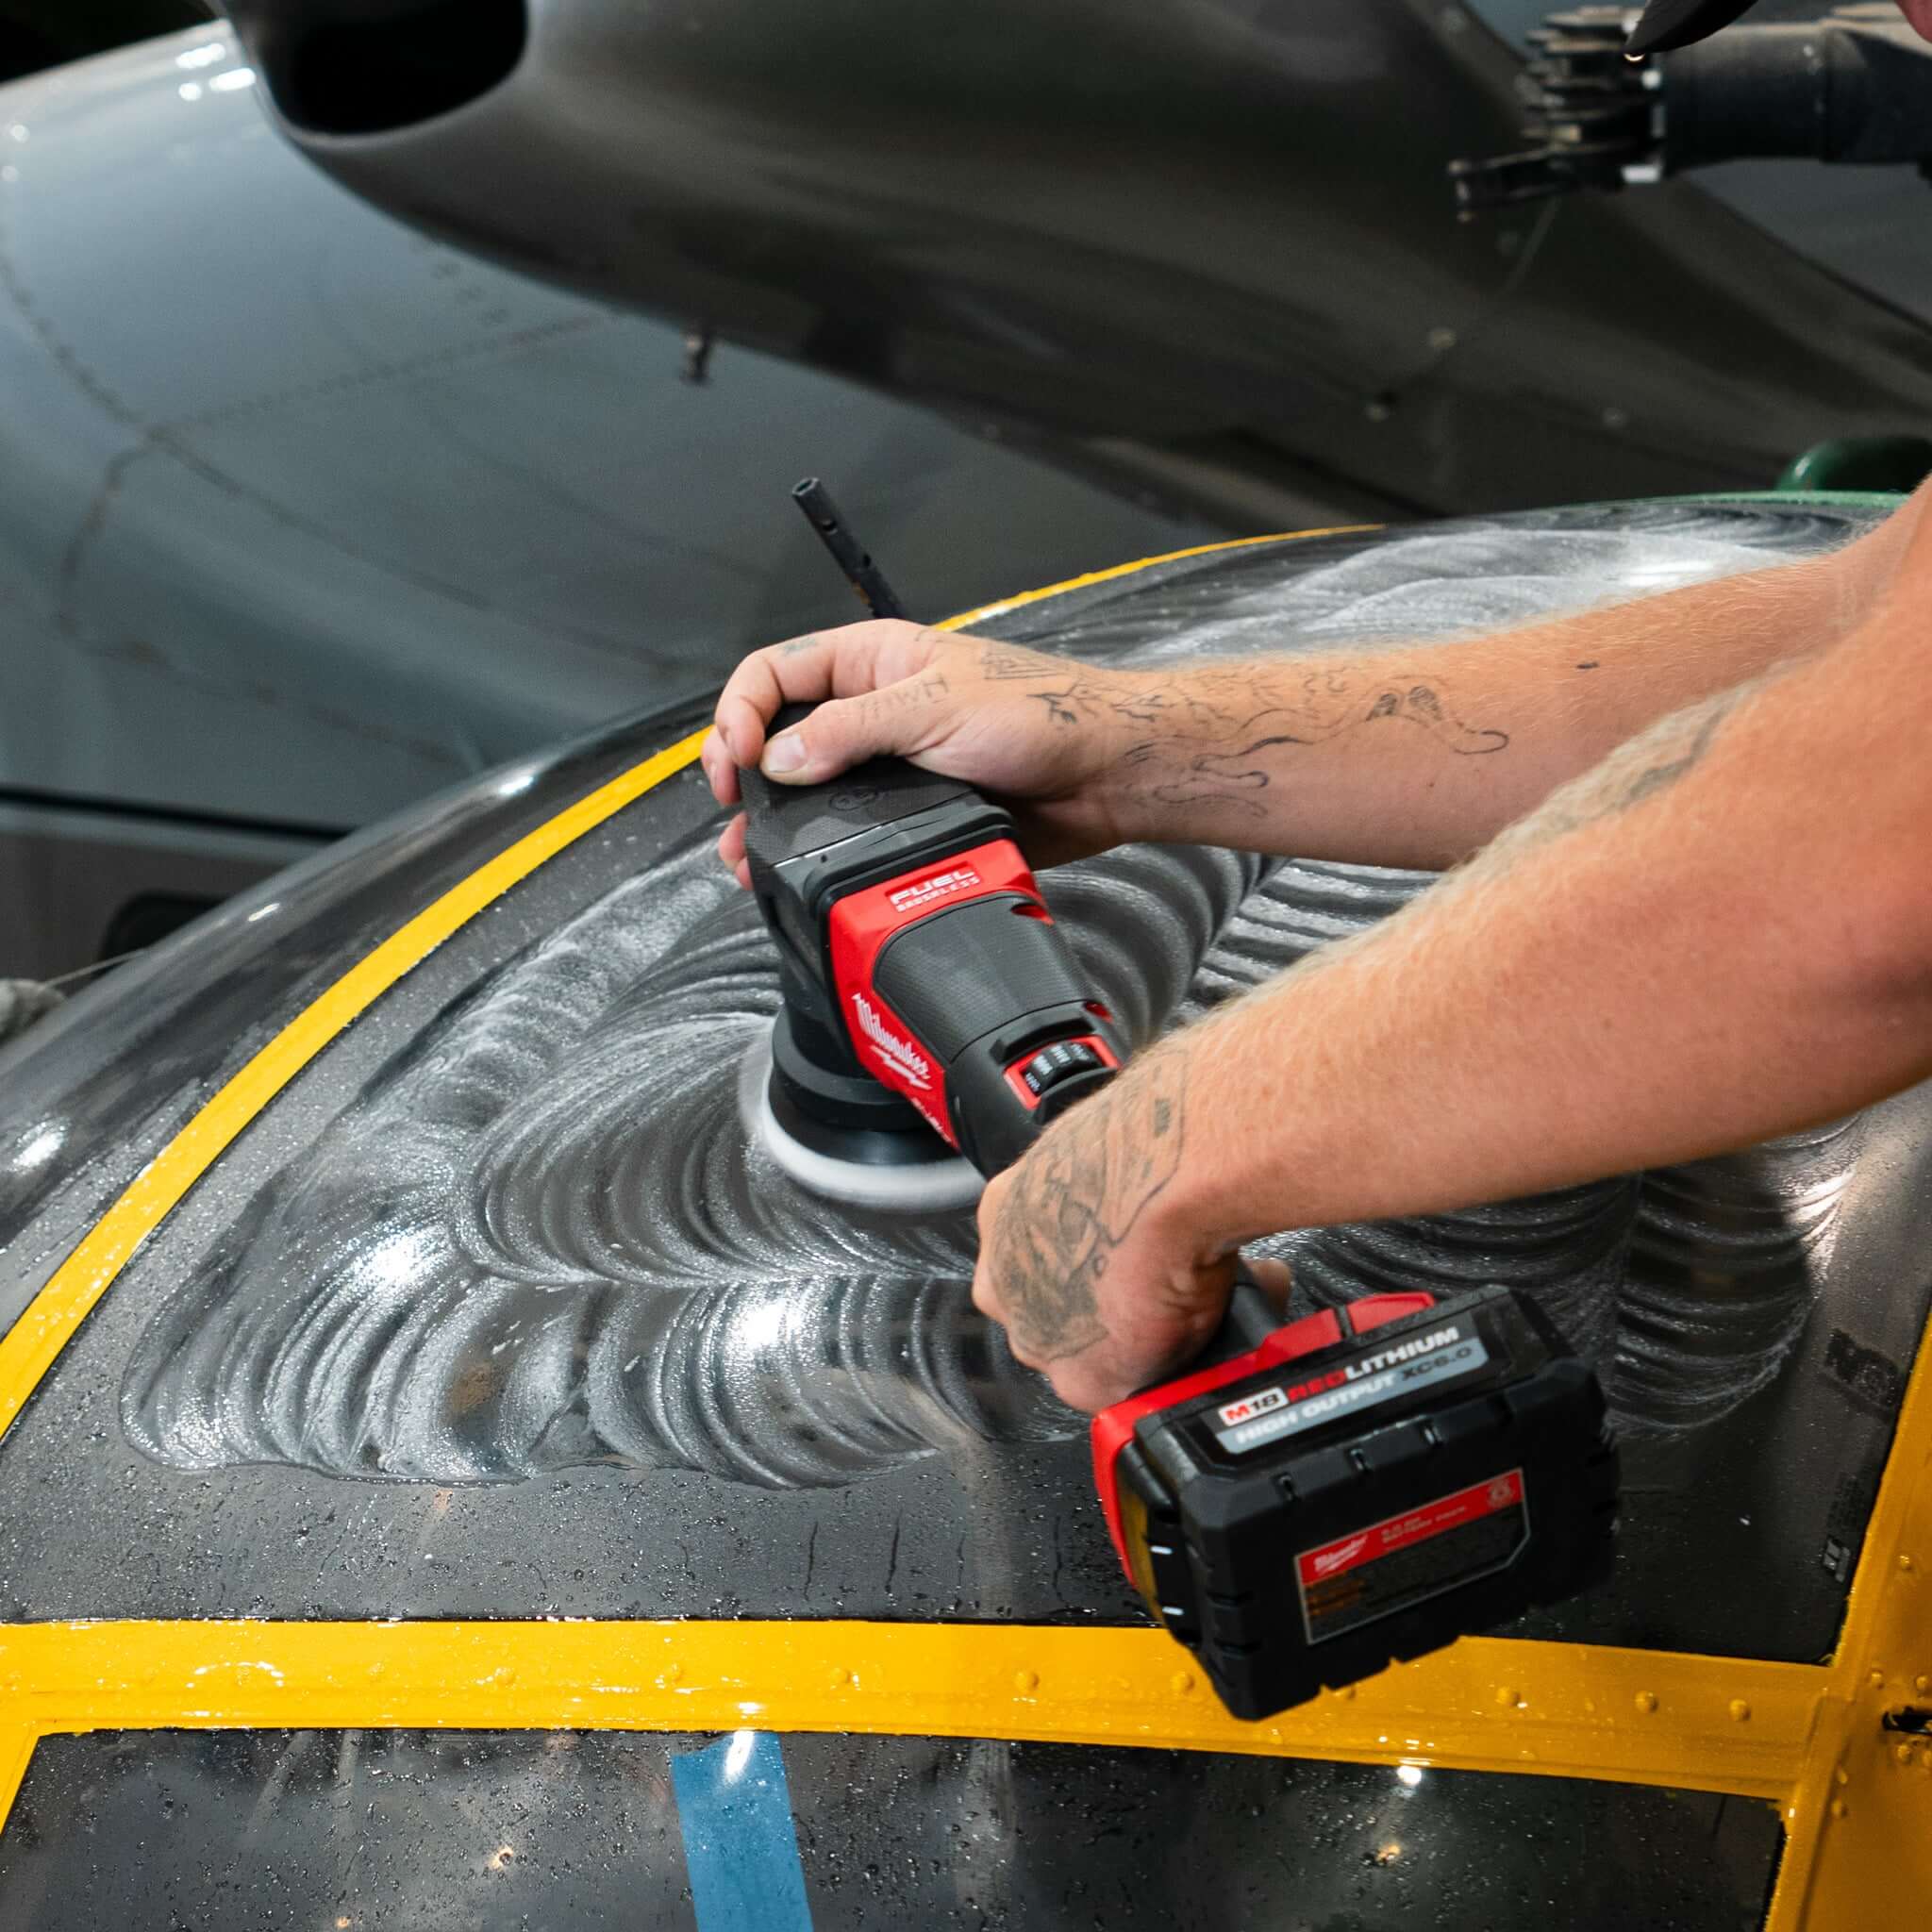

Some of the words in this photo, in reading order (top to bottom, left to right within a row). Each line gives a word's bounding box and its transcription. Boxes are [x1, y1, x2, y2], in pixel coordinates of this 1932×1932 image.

[890, 870, 975, 906] FUEL
[1224, 1391, 1281, 1422] M18
[1235, 1408, 1298, 1444] HIGH
[1302, 1371, 1398, 1414] OUTPUT
